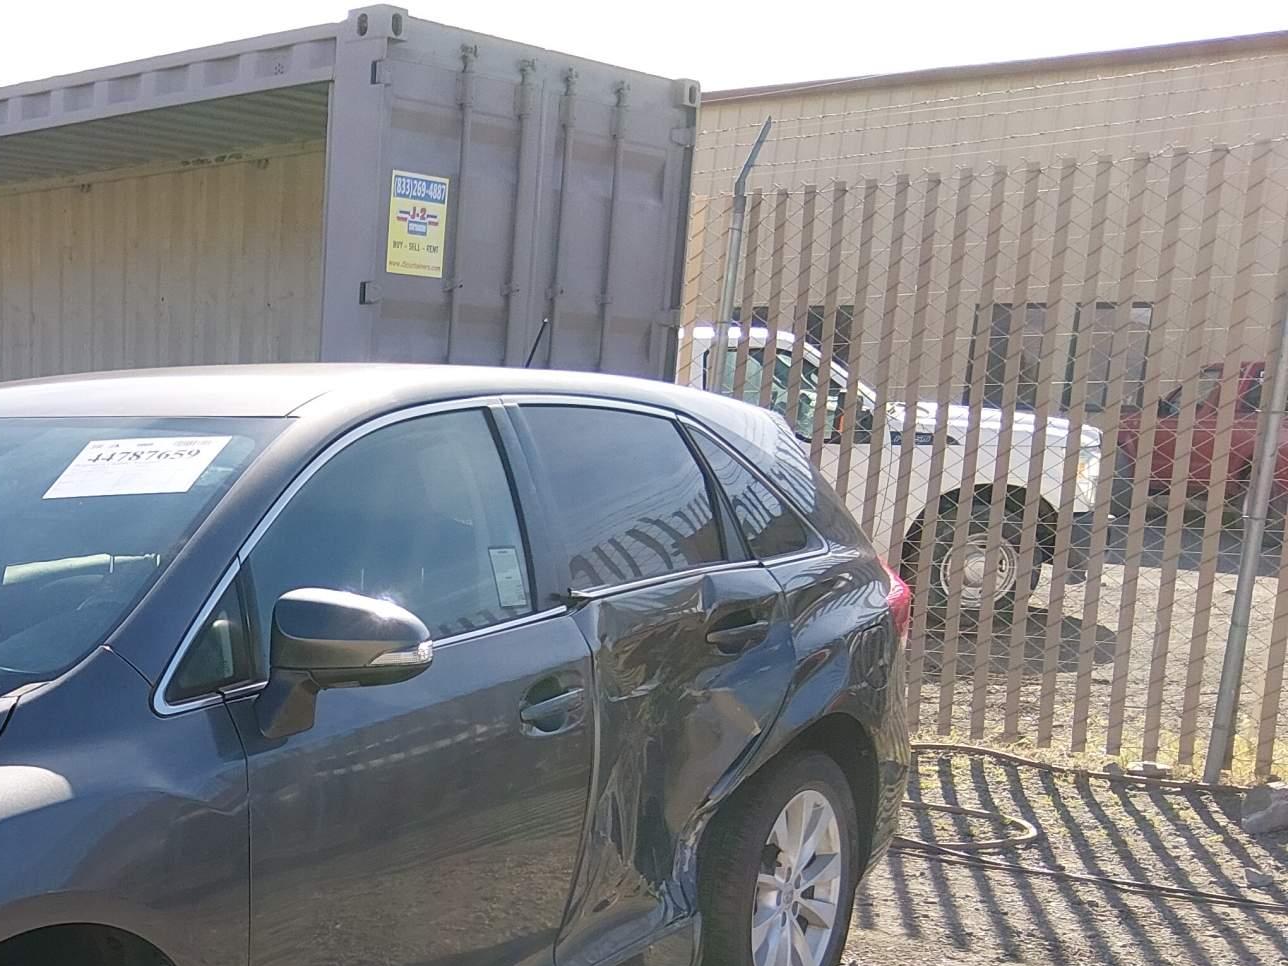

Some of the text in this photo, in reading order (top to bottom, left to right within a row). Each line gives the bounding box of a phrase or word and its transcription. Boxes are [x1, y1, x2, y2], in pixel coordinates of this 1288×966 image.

[395, 177, 446, 200] (833)269-4887
[393, 240, 403, 249] BUY
[408, 242, 420, 252] SELL
[426, 244, 439, 254] RENT
[88, 449, 201, 463] 44787659
